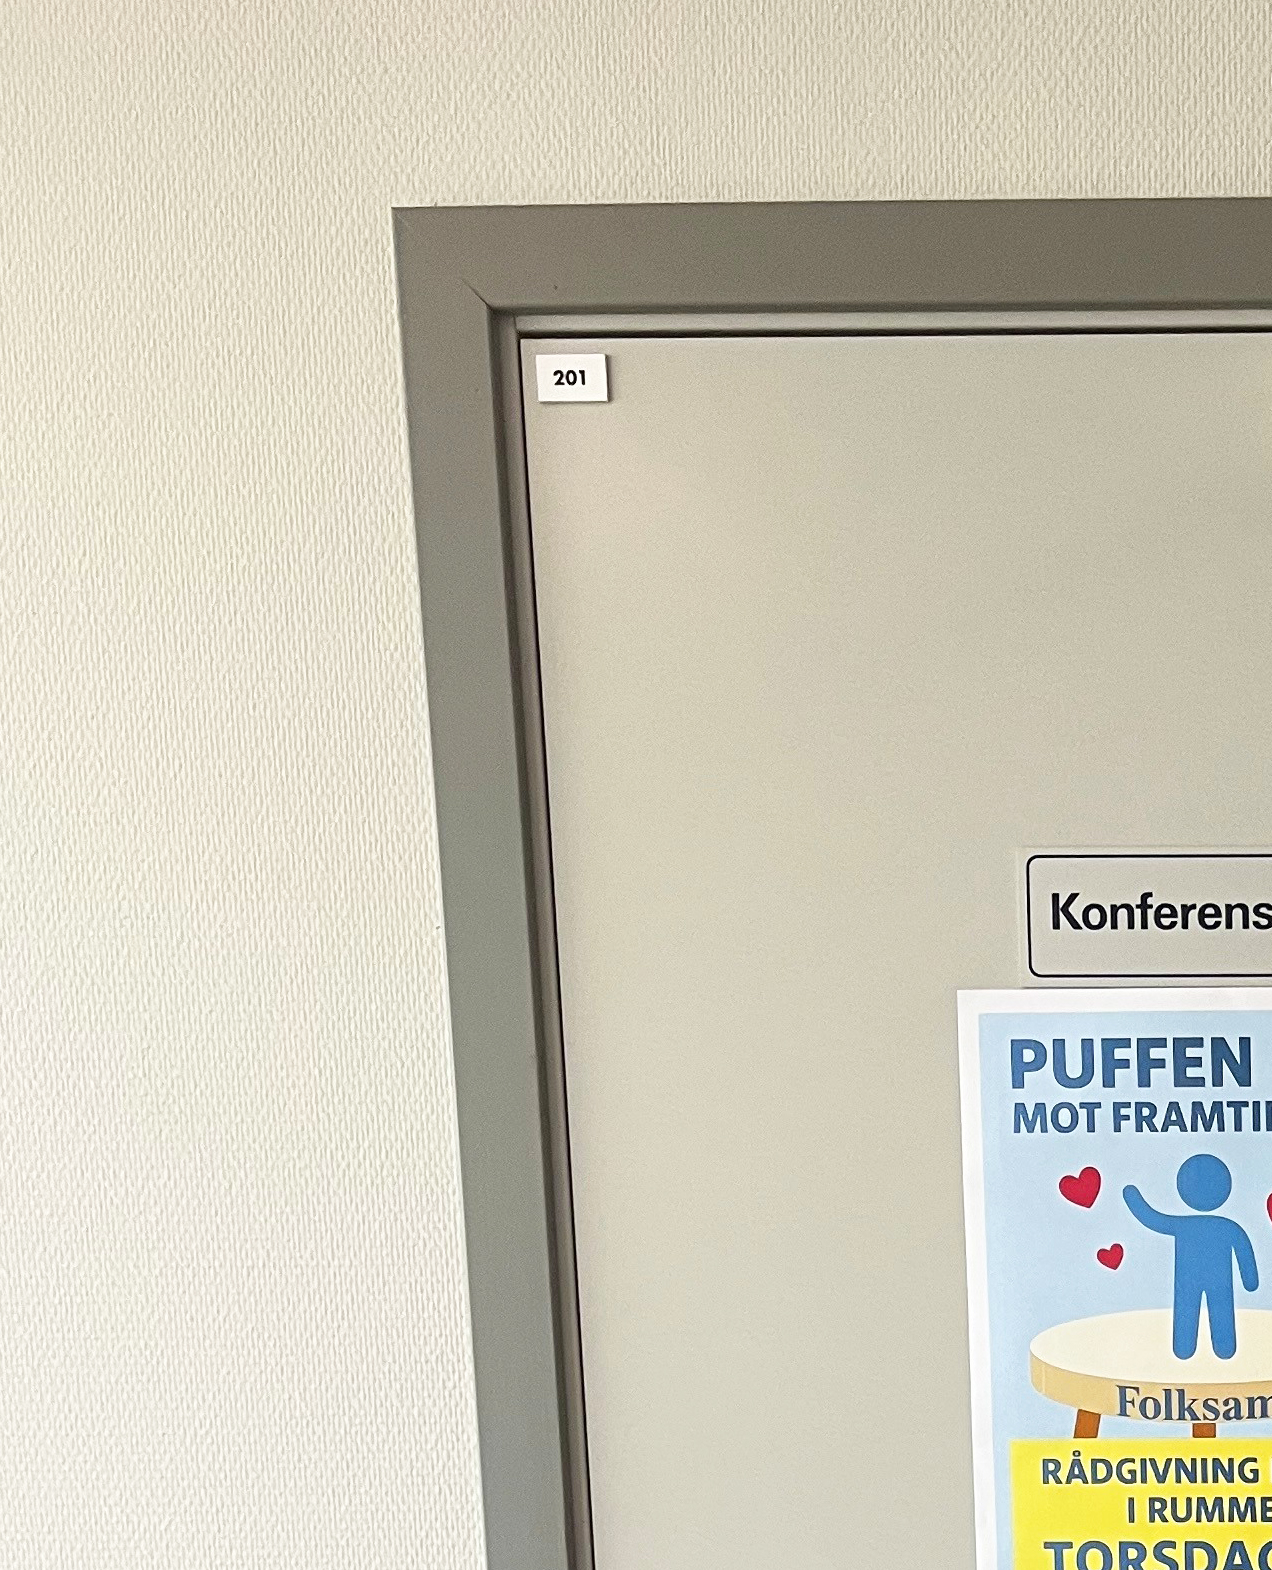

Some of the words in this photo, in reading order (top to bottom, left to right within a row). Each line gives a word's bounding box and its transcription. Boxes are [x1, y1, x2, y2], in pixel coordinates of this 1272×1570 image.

[553, 369, 587, 386] 201
[1010, 1036, 1252, 1090] PUFFEN
[1012, 1102, 1103, 1134] MOT
[1041, 1450, 1260, 1485] RÅDGIVNING
[1127, 1496, 1135, 1524] I
